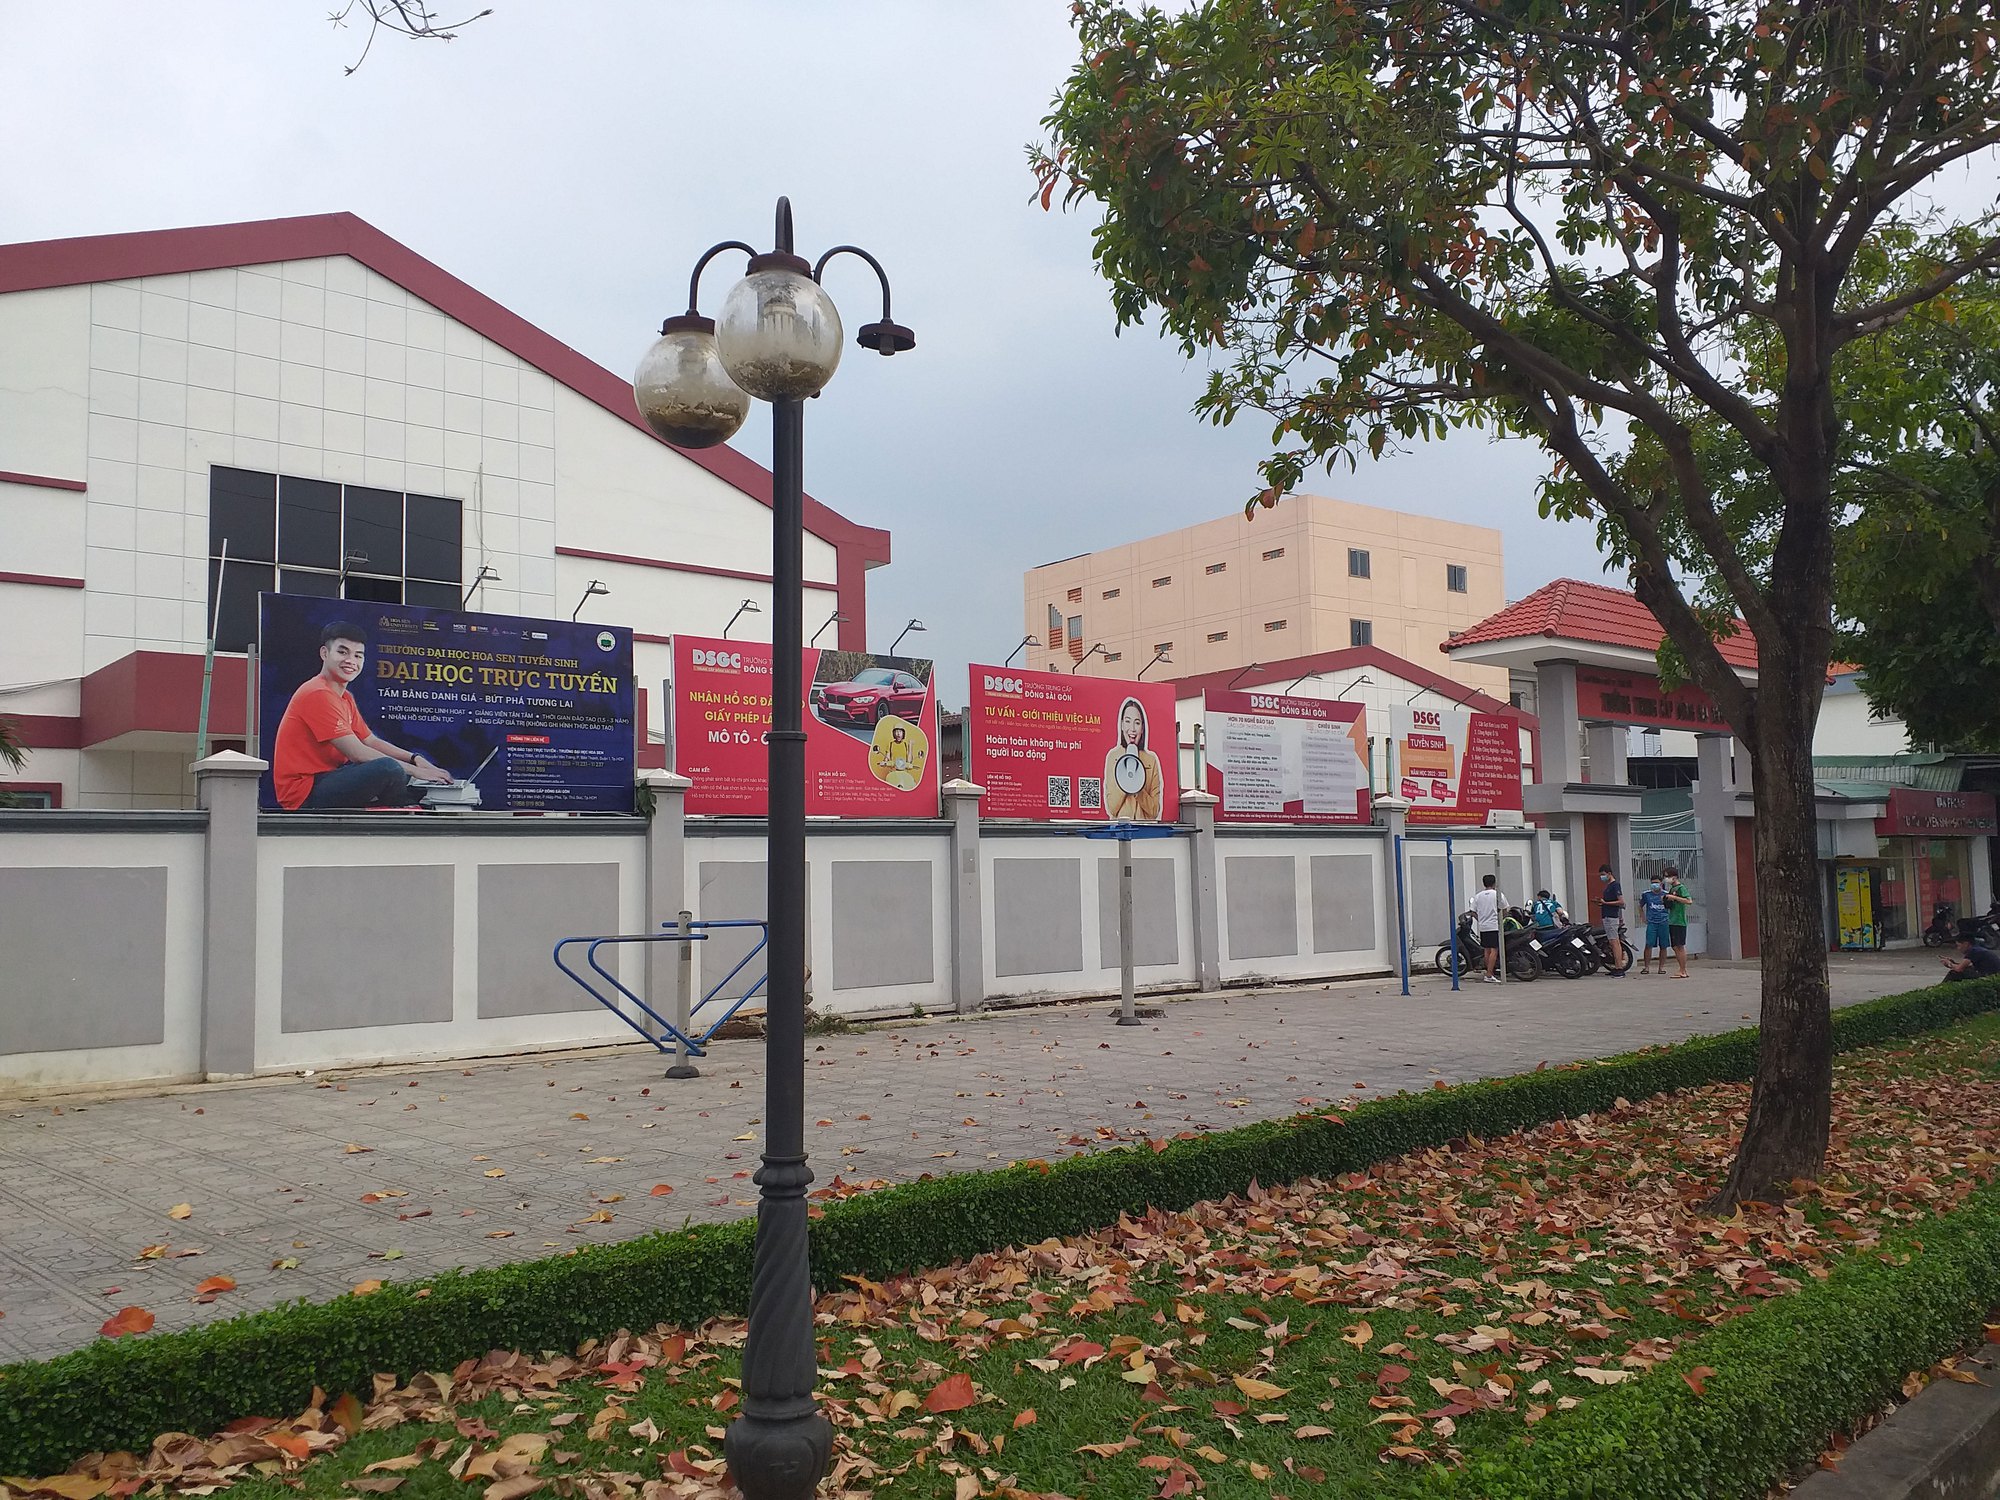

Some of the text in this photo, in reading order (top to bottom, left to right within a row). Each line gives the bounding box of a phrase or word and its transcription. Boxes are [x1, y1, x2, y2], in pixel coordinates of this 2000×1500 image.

[376, 643, 425, 656] TRƯỜNG
[427, 648, 446, 660] ĐẠI
[448, 649, 470, 661] HỌC
[471, 651, 494, 662] HOA
[496, 654, 516, 663] SEN
[554, 658, 578, 668] SINH
[692, 648, 741, 669] DSGC
[743, 656, 768, 665] TRƯỜNG
[376, 660, 618, 694] ĐẠI HỌC TRỰC TUYẾN
[743, 664, 767, 674] ĐÔNG
[983, 675, 1023, 694] DSGC
[378, 687, 399, 698] TẤM
[432, 692, 458, 701] DANH
[460, 693, 477, 702] GIÁ
[485, 694, 504, 704] BỨT
[505, 695, 525, 706] PHÁ
[526, 698, 557, 707] TƯƠNG
[559, 700, 573, 708] LAI
[689, 690, 721, 705] NHẬN
[724, 690, 740, 705] HỒ
[743, 695, 757, 706] SƠ
[1024, 690, 1072, 702] ĐÔNG SÀI GÒN
[1250, 695, 1280, 710] DSGC
[704, 707, 731, 722] GIẤY
[734, 711, 760, 724] PHÉP
[985, 706, 996, 716] TƯ
[997, 704, 1015, 718] VẤN
[1021, 708, 1040, 720] GIỚI
[1041, 710, 1063, 724] THIỆU
[1065, 712, 1083, 726] VIỆC
[1085, 714, 1101, 725] LÀM
[1281, 705, 1327, 717] ĐÔNG SÀI GÒN
[1413, 710, 1440, 726] DSGC
[708, 728, 730, 743] MÔ
[733, 729, 750, 745] TÔ
[986, 734, 1082, 751] Hoàn toàn không thu phí
[1410, 735, 1444, 749] TUYỂN SINH
[986, 748, 1047, 761] người lao động
